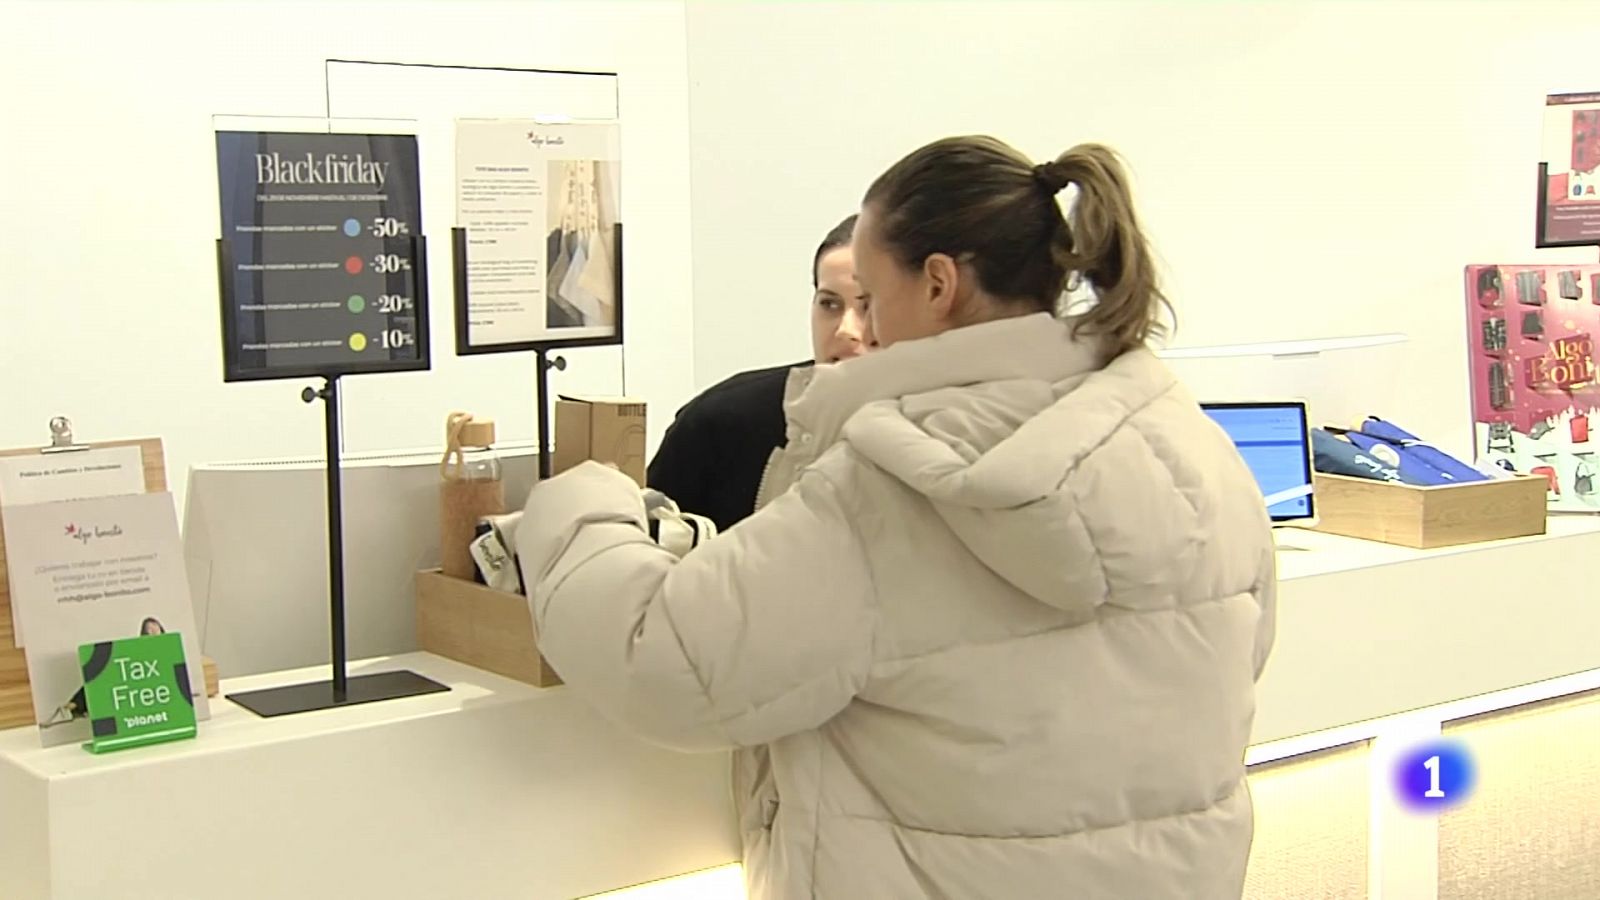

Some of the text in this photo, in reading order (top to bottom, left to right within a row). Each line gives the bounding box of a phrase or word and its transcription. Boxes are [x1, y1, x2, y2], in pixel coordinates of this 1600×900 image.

[367, 217, 409, 237] -50%
[369, 254, 411, 273] -30%
[371, 294, 413, 313] -20%
[372, 329, 414, 349] -10%
[1545, 339, 1593, 365] Algo
[114, 657, 160, 682] Tax
[112, 685, 170, 710] Free
[123, 711, 168, 728] planet
